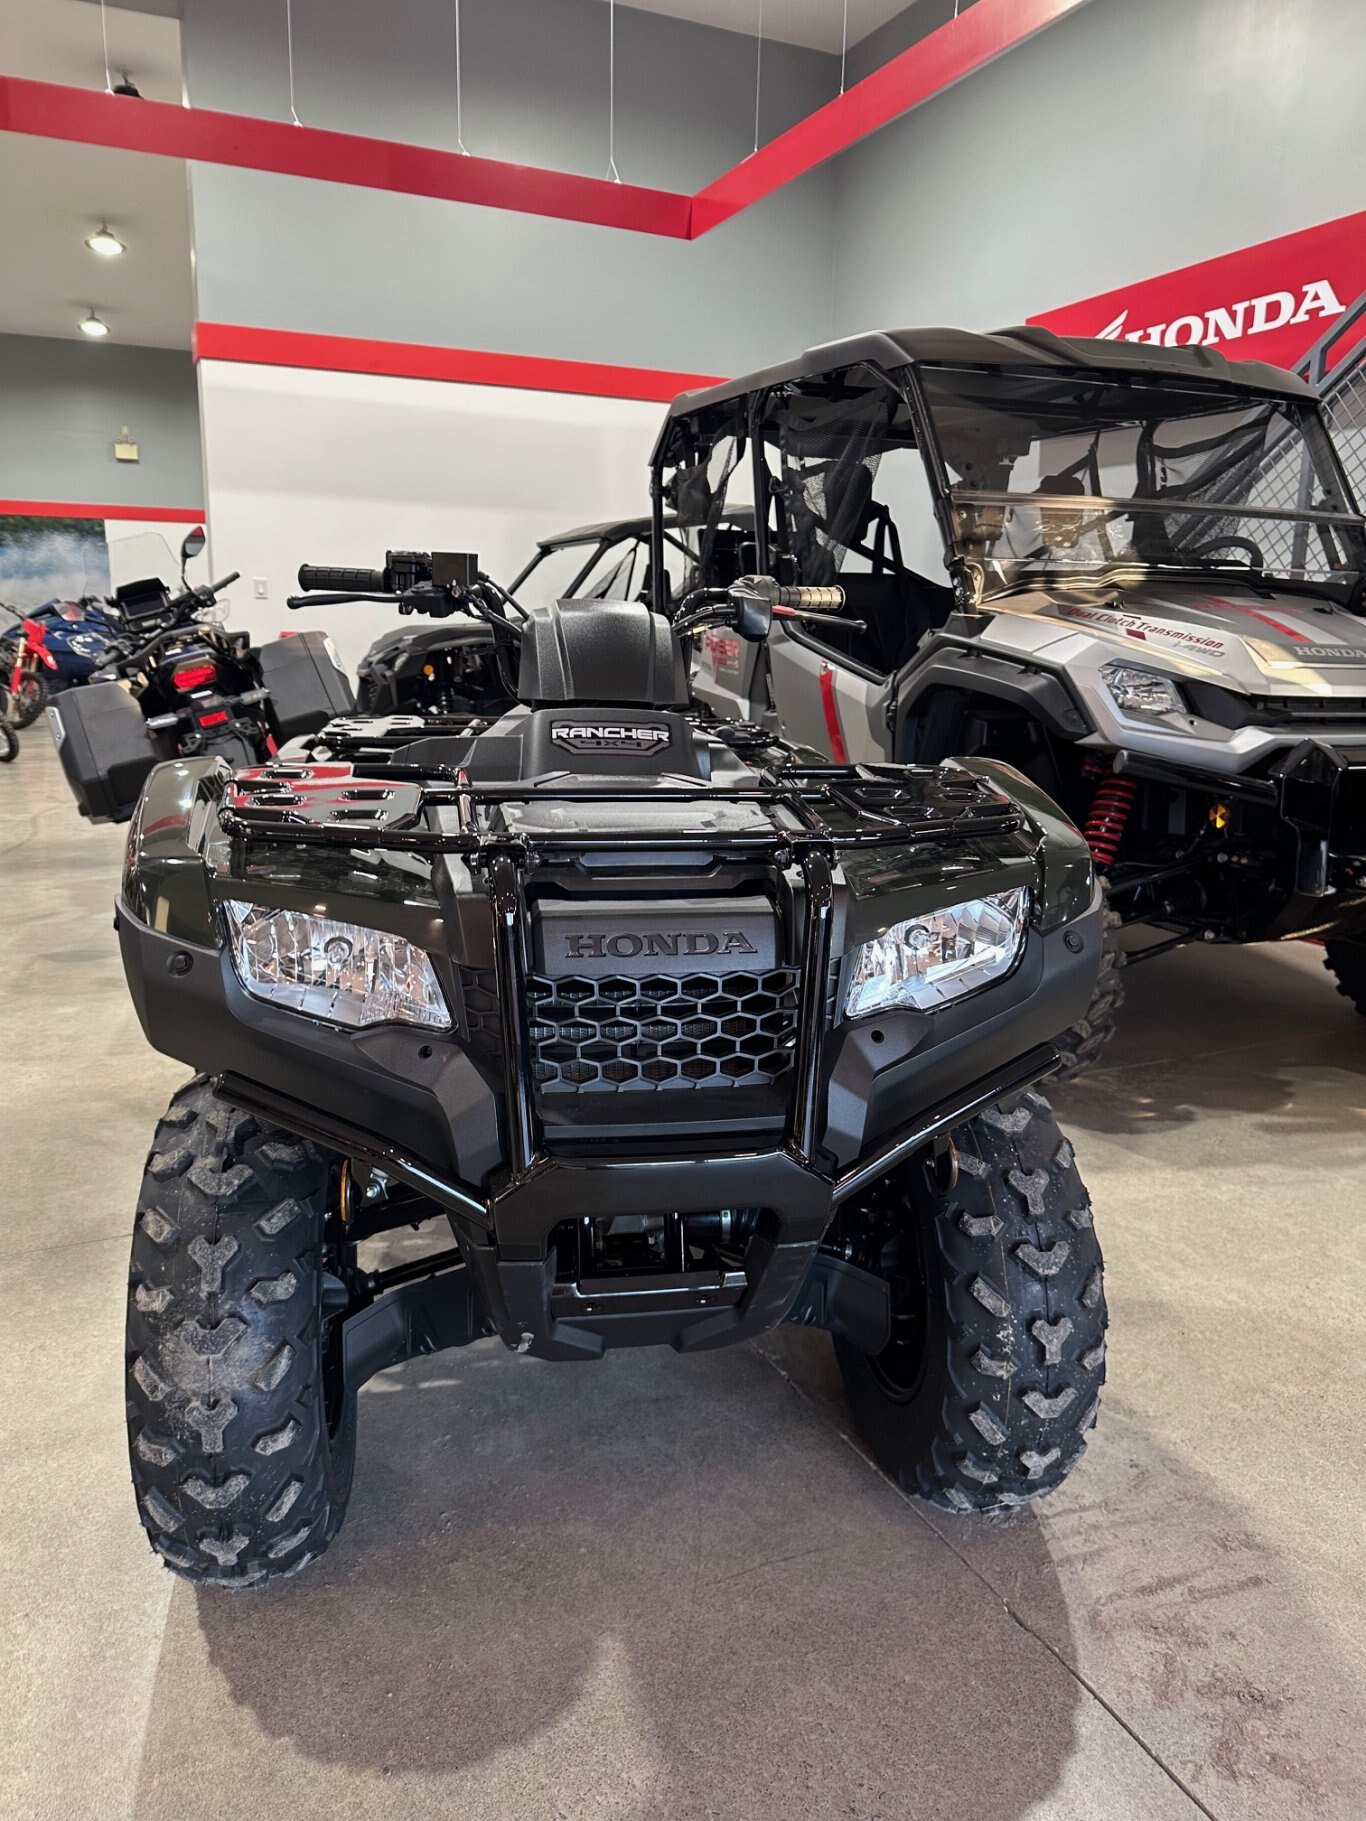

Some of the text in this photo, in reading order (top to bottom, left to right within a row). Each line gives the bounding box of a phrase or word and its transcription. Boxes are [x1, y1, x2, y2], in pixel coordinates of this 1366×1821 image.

[1125, 279, 1347, 348] HONDA
[1066, 607, 1225, 649] Dual Clutch Transmission
[1293, 646, 1366, 658] HONDA
[551, 727, 670, 742] RANCHER
[565, 931, 758, 958] HONDA
